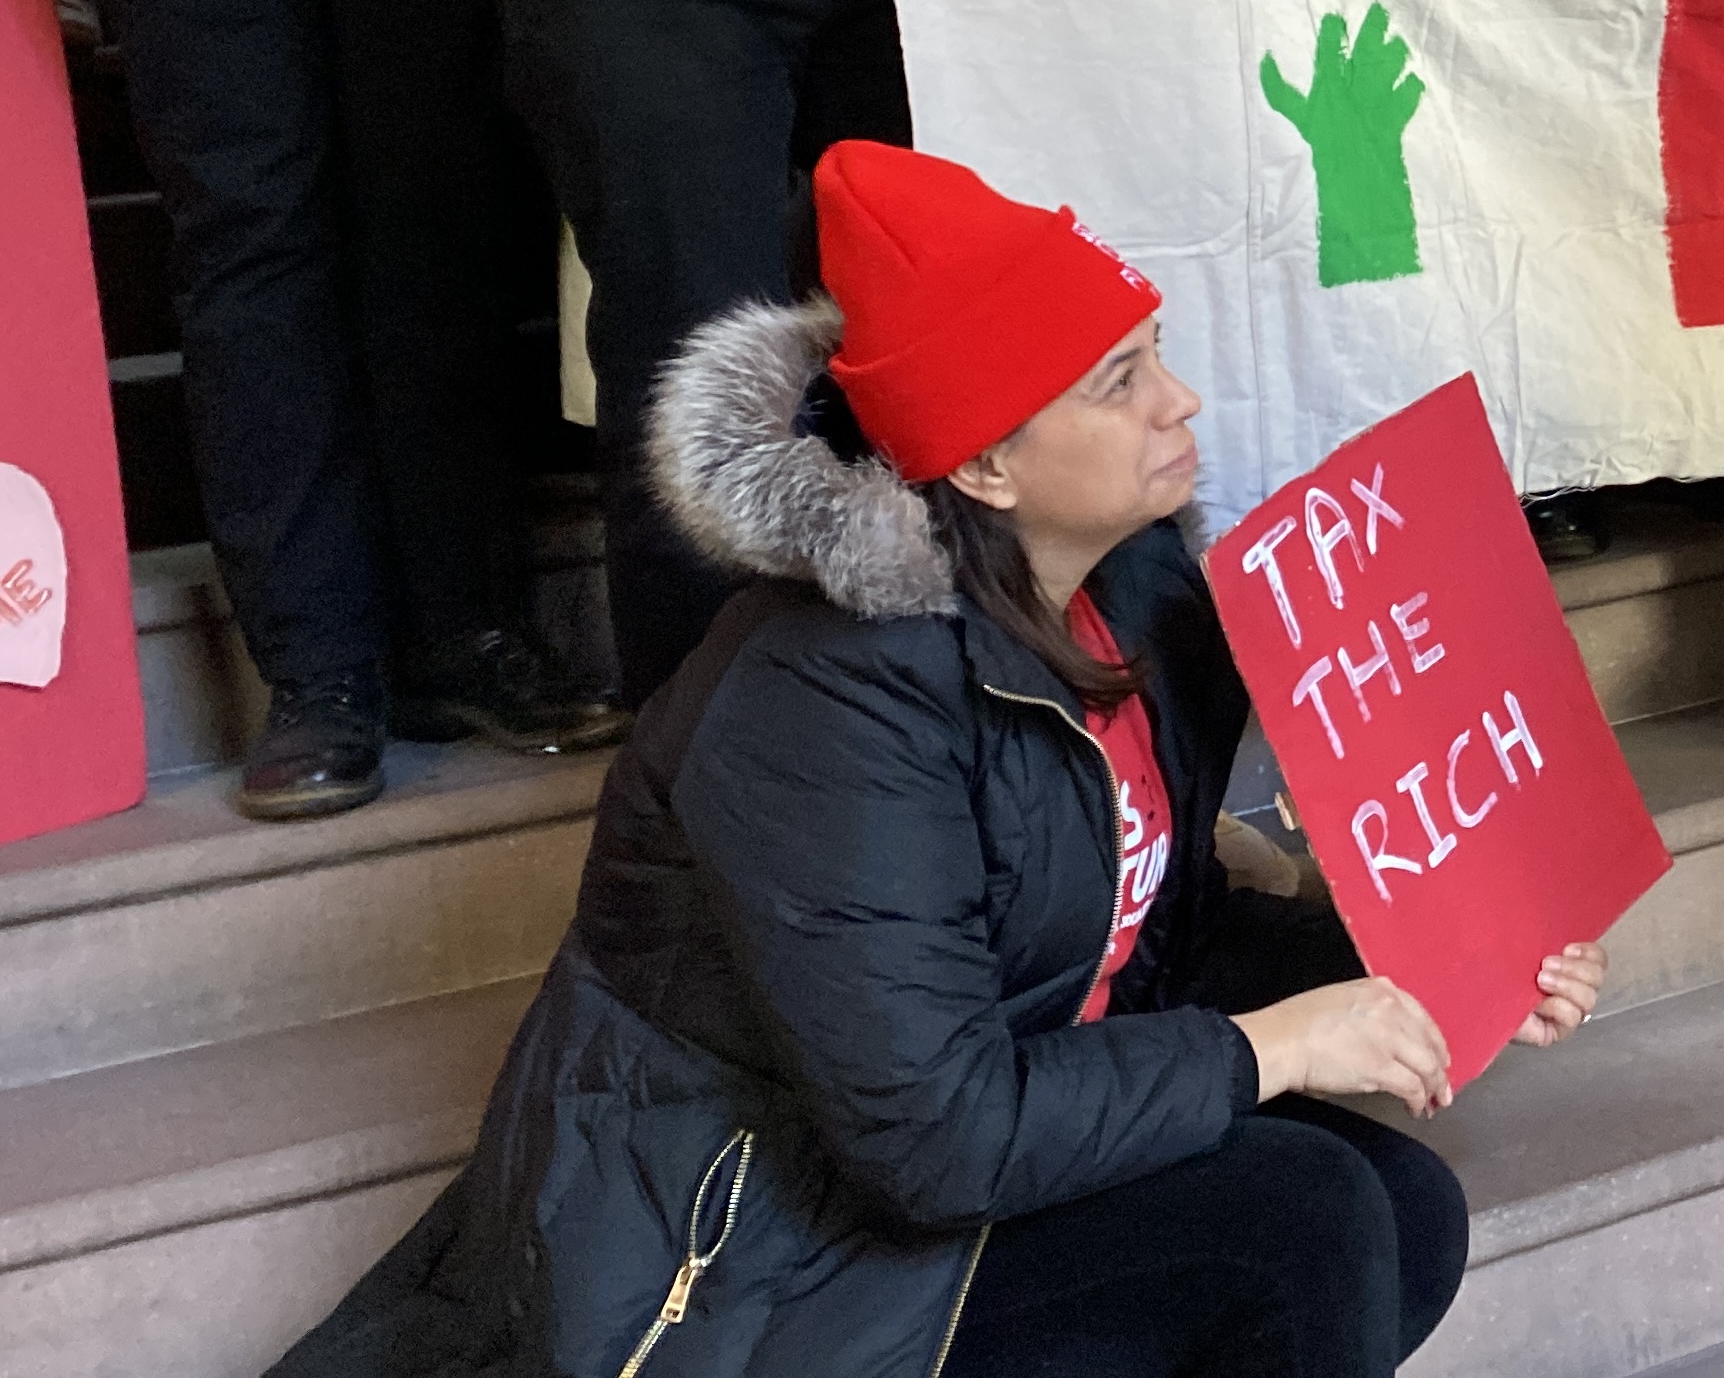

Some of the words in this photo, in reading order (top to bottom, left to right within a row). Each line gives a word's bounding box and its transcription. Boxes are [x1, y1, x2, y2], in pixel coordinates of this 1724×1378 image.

[1242, 462, 1404, 649] TAX
[1292, 591, 1446, 759] THE
[1351, 690, 1546, 903] RICH
